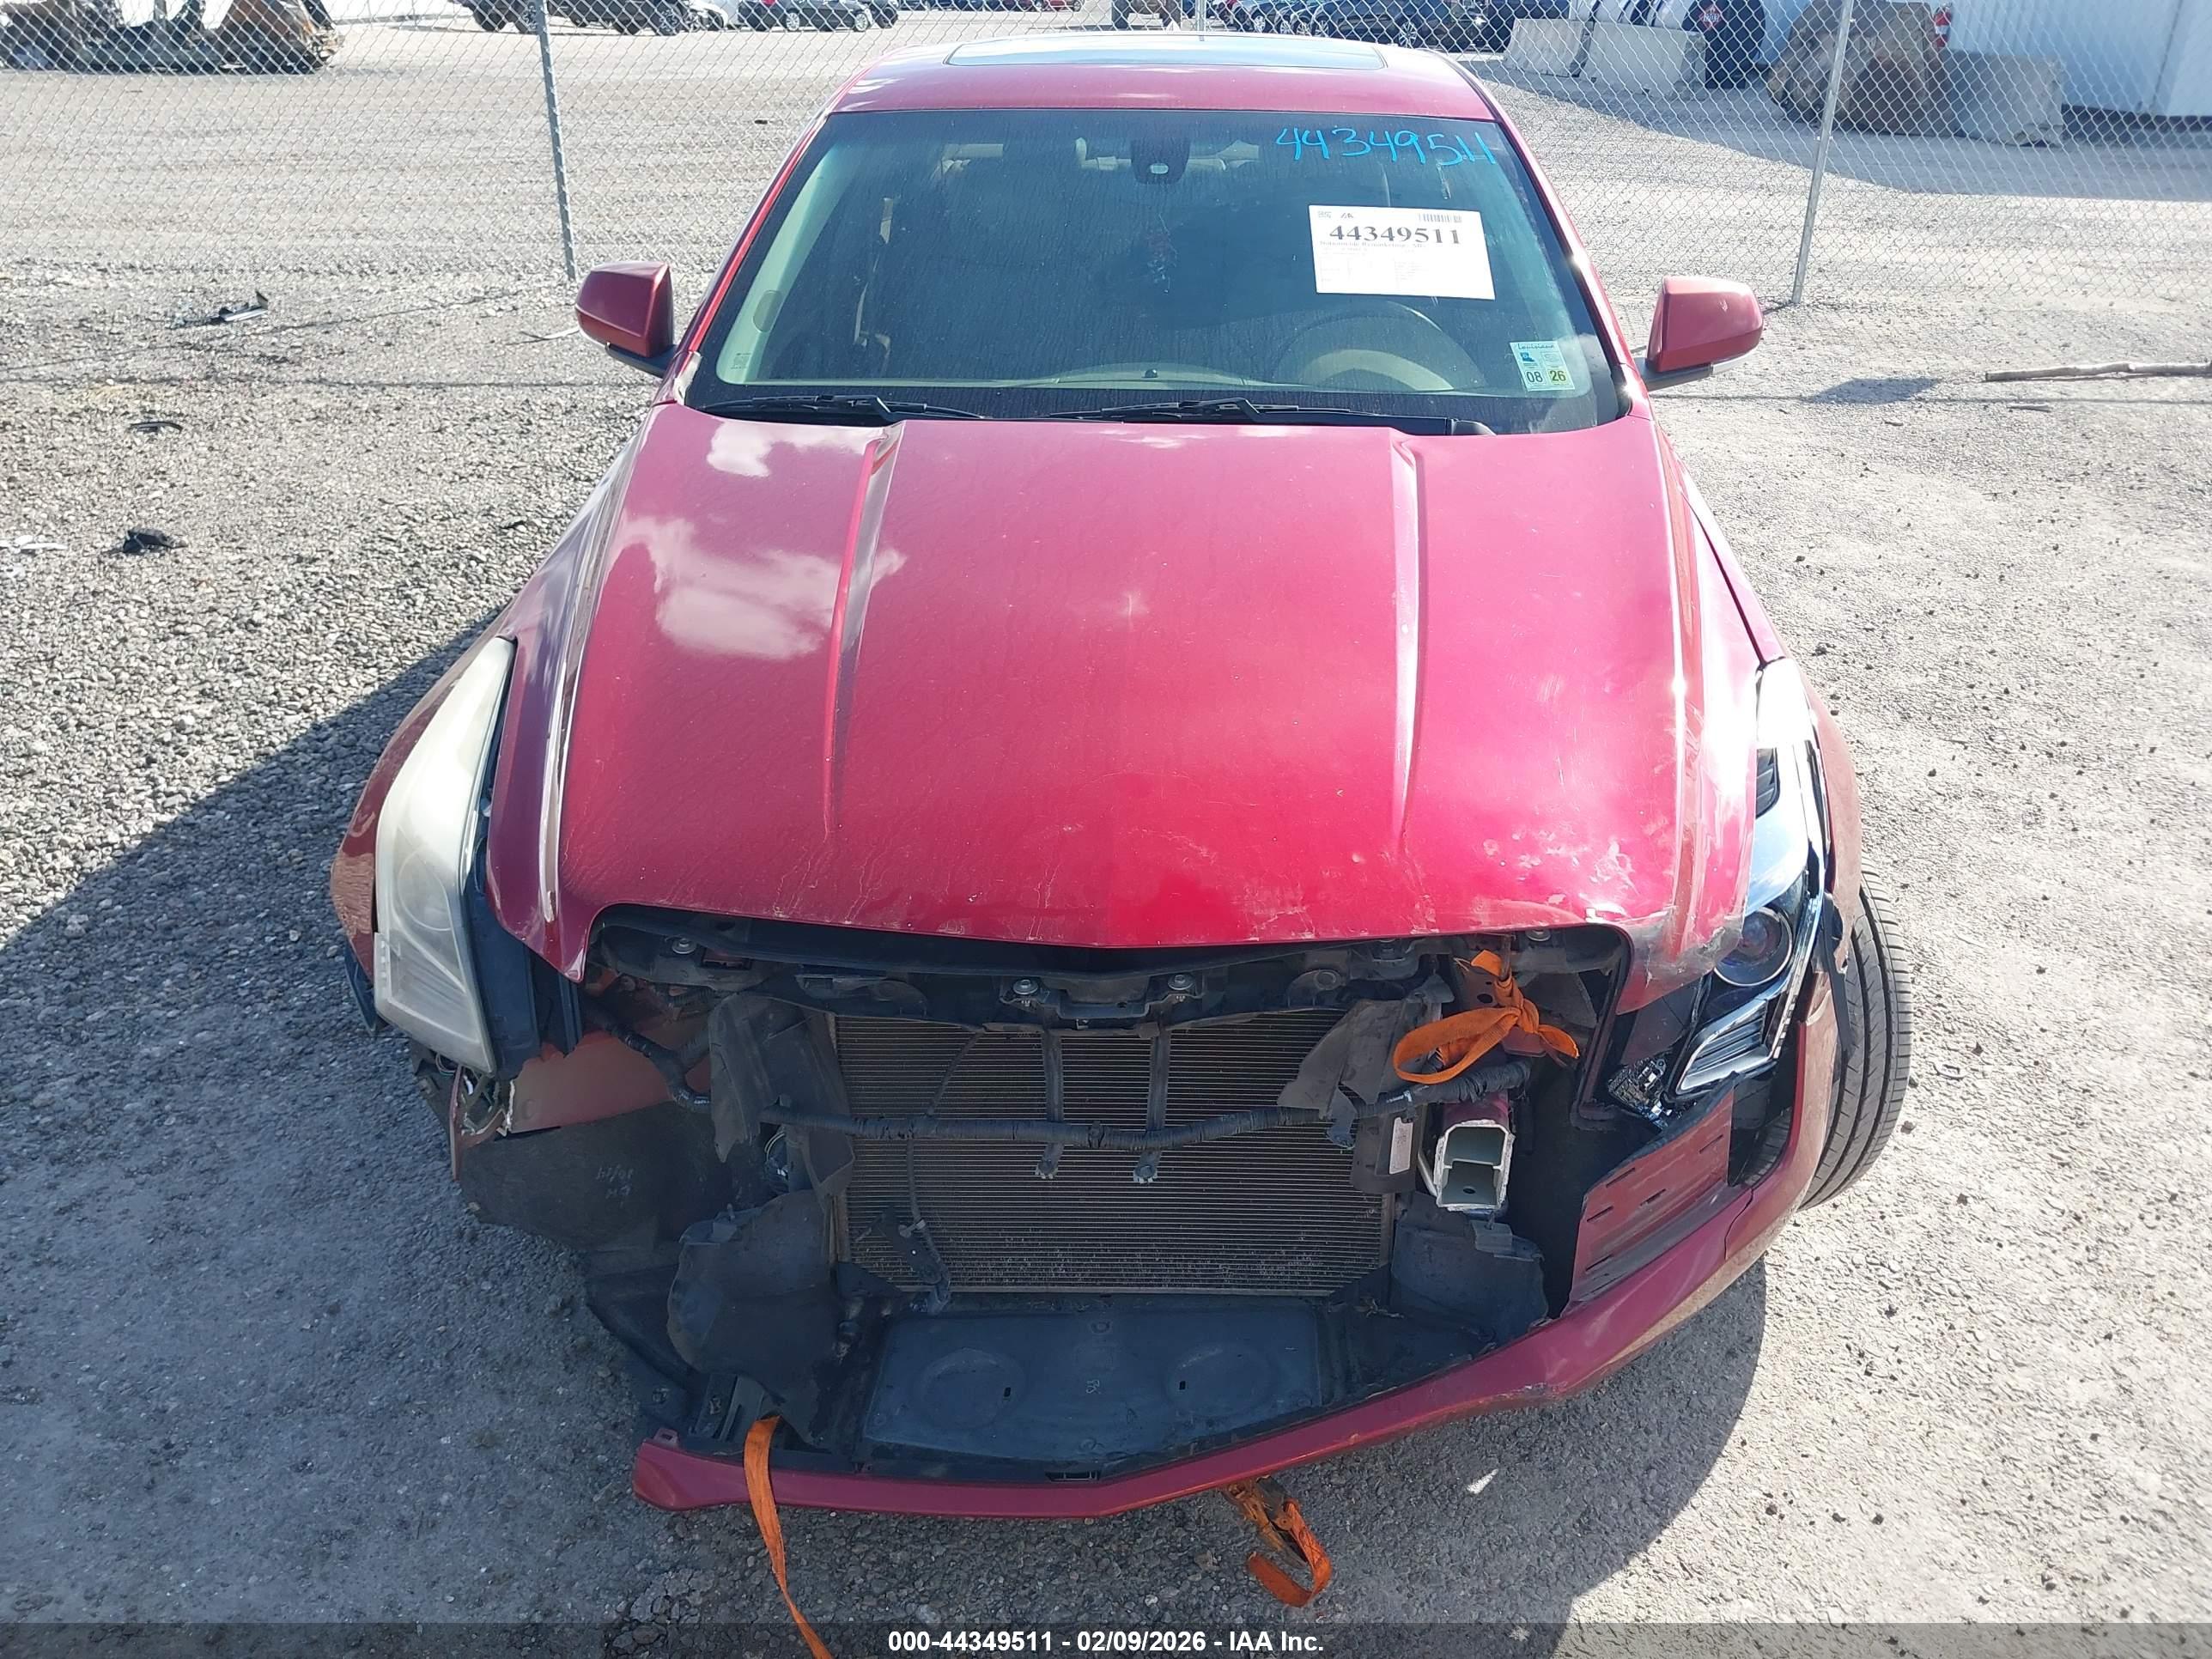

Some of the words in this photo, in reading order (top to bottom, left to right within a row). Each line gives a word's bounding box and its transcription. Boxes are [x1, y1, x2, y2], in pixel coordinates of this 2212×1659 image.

[1276, 127, 1497, 165] 44349511
[1329, 225, 1462, 245] 44349511
[1526, 371, 1543, 383] 08
[1549, 370, 1566, 381] 26
